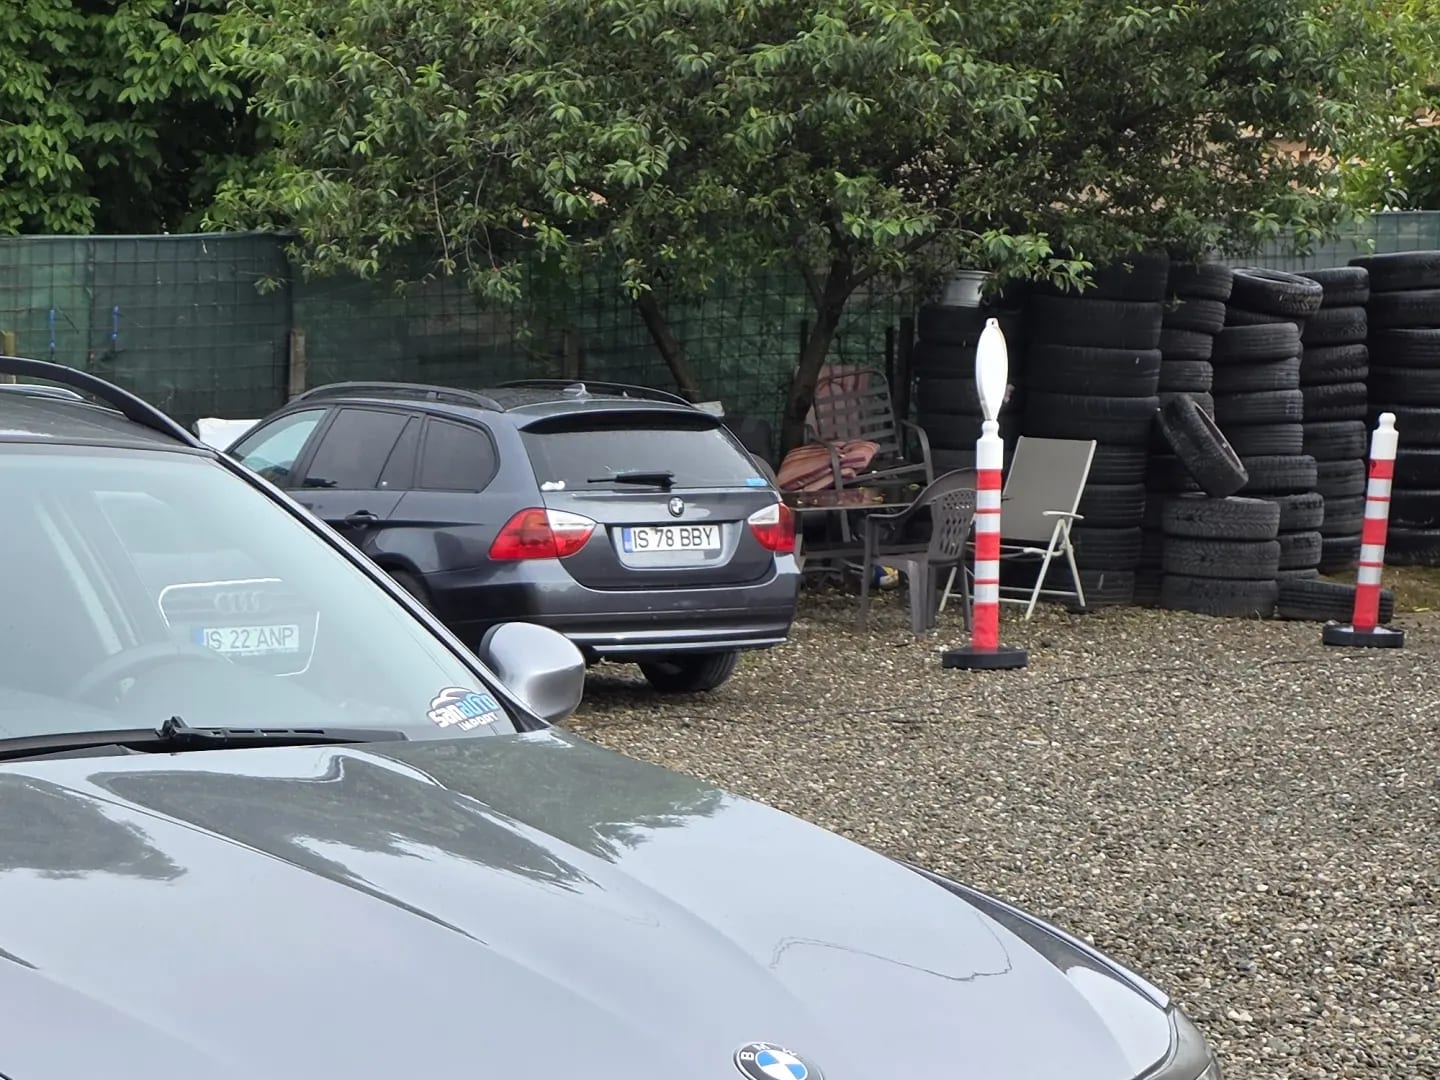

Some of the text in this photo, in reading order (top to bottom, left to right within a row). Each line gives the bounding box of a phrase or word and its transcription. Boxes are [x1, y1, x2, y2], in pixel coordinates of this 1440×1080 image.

[633, 527, 713, 549] IS 78 BBY
[230, 629, 251, 649] 22
[257, 627, 294, 649] ANP
